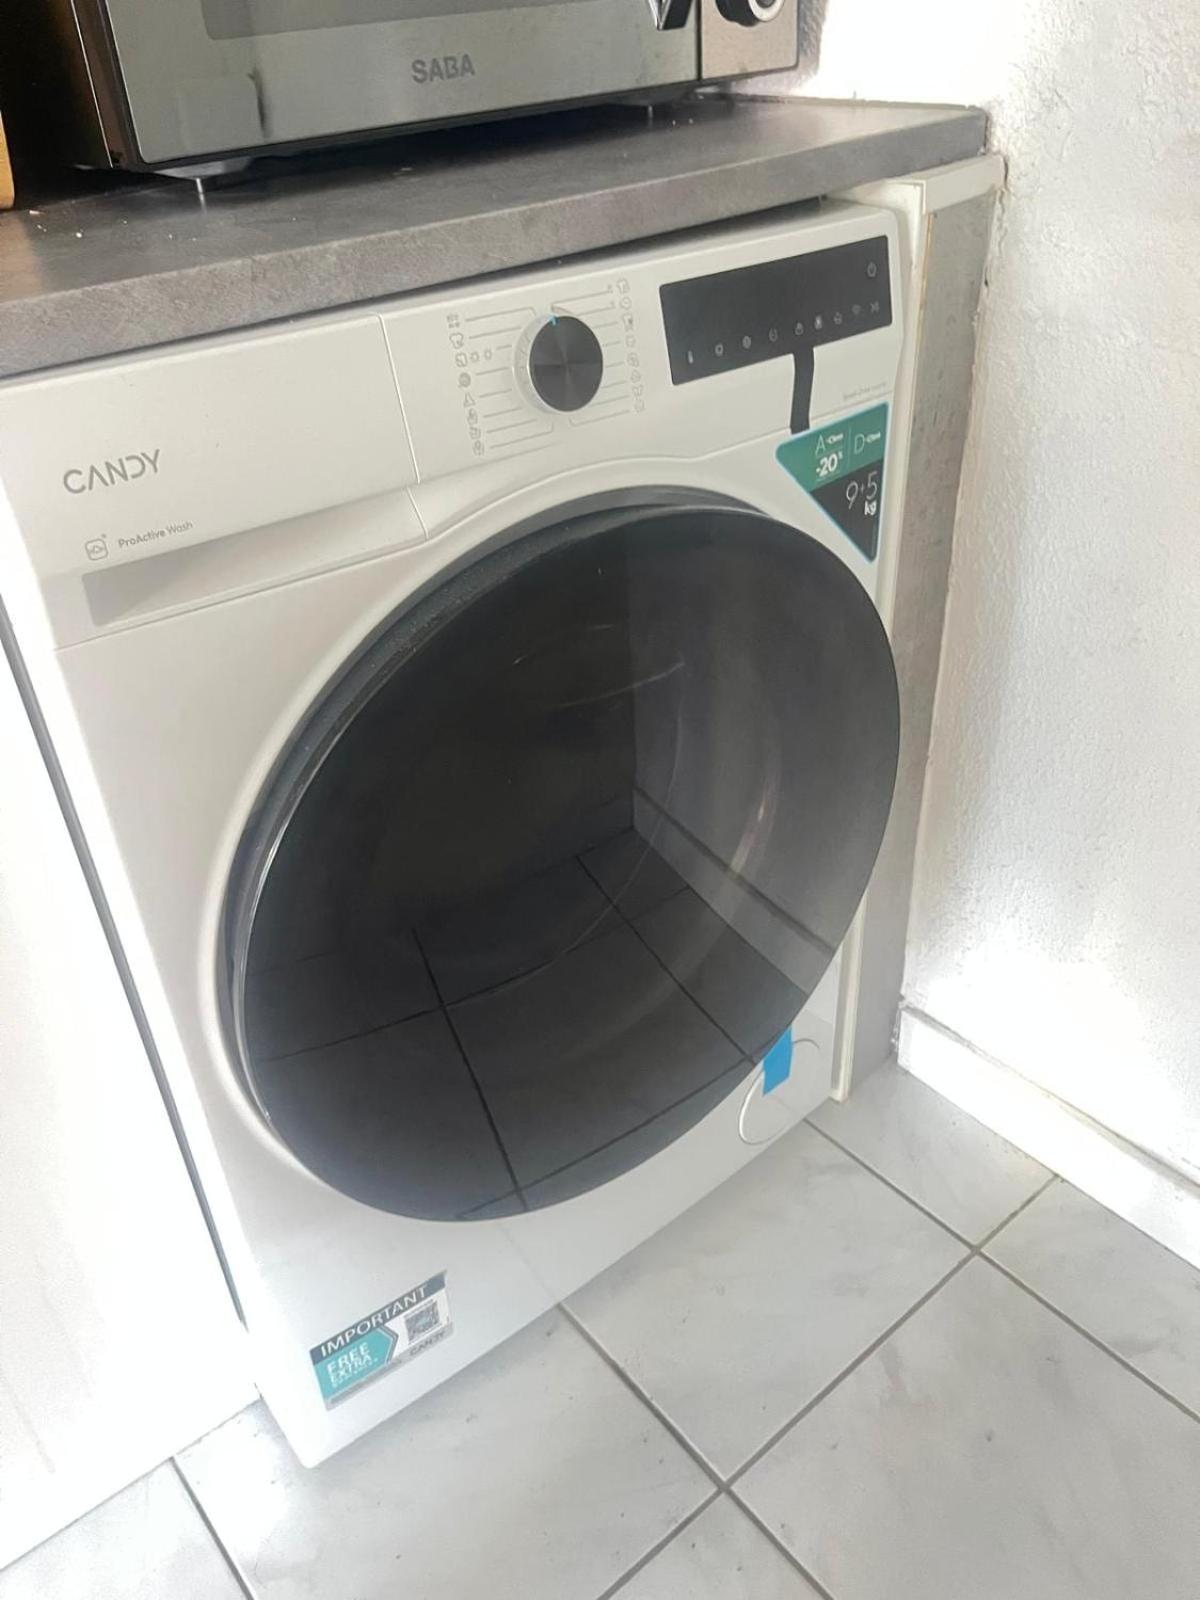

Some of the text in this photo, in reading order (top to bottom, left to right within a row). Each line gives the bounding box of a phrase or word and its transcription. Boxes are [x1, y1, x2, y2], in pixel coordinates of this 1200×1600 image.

[411, 53, 476, 84] SABA
[63, 448, 161, 494] CANDY
[864, 500, 877, 516] kg
[118, 520, 193, 549] ProActive Wash
[320, 1283, 429, 1358] IMPORTANT
[327, 1342, 370, 1374] FREE
